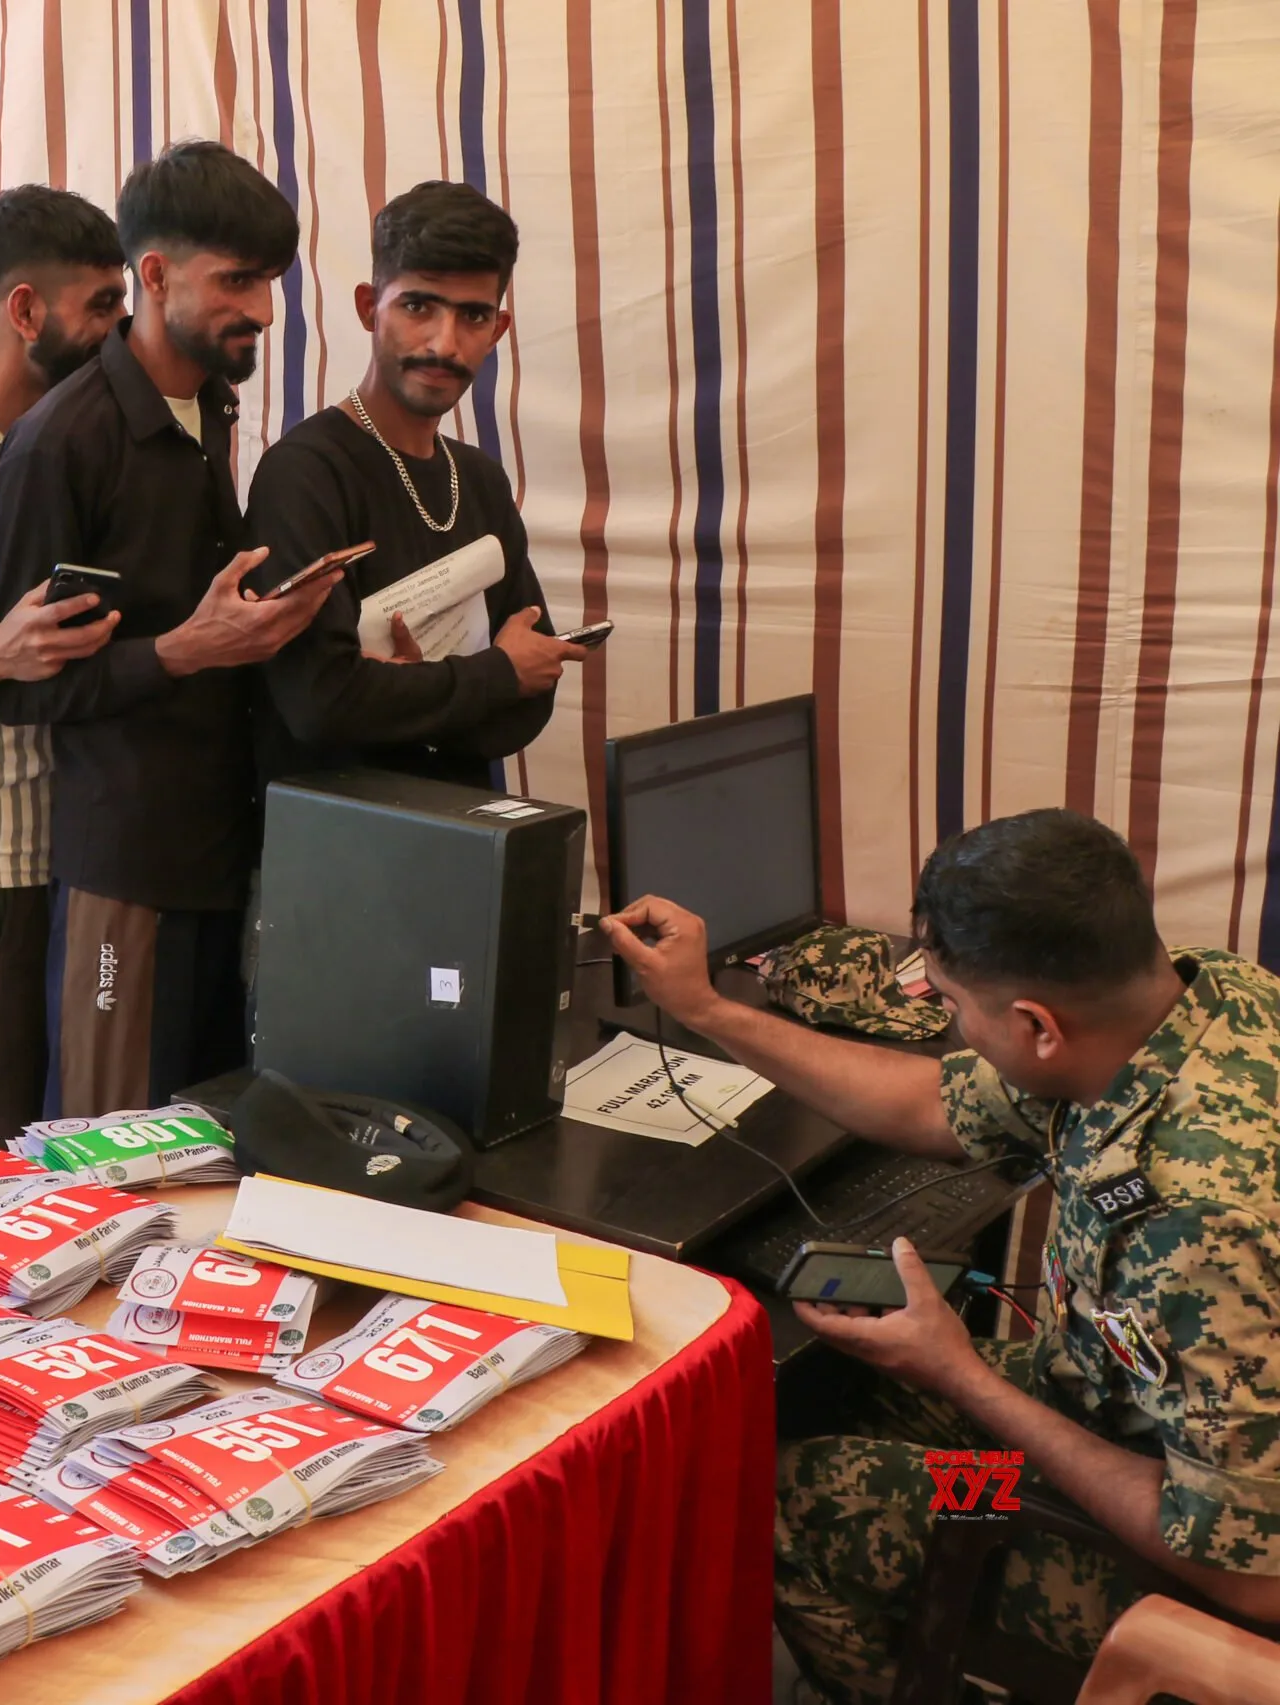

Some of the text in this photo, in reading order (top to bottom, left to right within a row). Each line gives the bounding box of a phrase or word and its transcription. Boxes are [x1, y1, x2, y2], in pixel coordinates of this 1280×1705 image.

[438, 567, 450, 577] BSF
[382, 596, 413, 614] Marathon
[99, 943, 117, 988] adidas
[597, 1054, 689, 1115] FULL MARATHON
[645, 1072, 704, 1111] 42.19 KM
[100, 1118, 205, 1149] 801
[1093, 1178, 1145, 1214] BSF
[96, 1219, 122, 1240] Farid
[226, 1306, 245, 1314] FULL
[235, 1338, 253, 1346] FULL
[363, 1313, 483, 1383] 671
[11, 1337, 141, 1380] 521
[91, 1385, 123, 1401] Uttam
[121, 1374, 153, 1393] Kumar
[370, 1400, 392, 1411] FULL
[191, 1412, 329, 1463] 551
[202, 1472, 223, 1489] FULL
[293, 1454, 336, 1483] Qamran
[168, 1494, 188, 1510] FULL
[125, 1520, 145, 1536] FULL
[20, 1556, 62, 1586] Kumar
